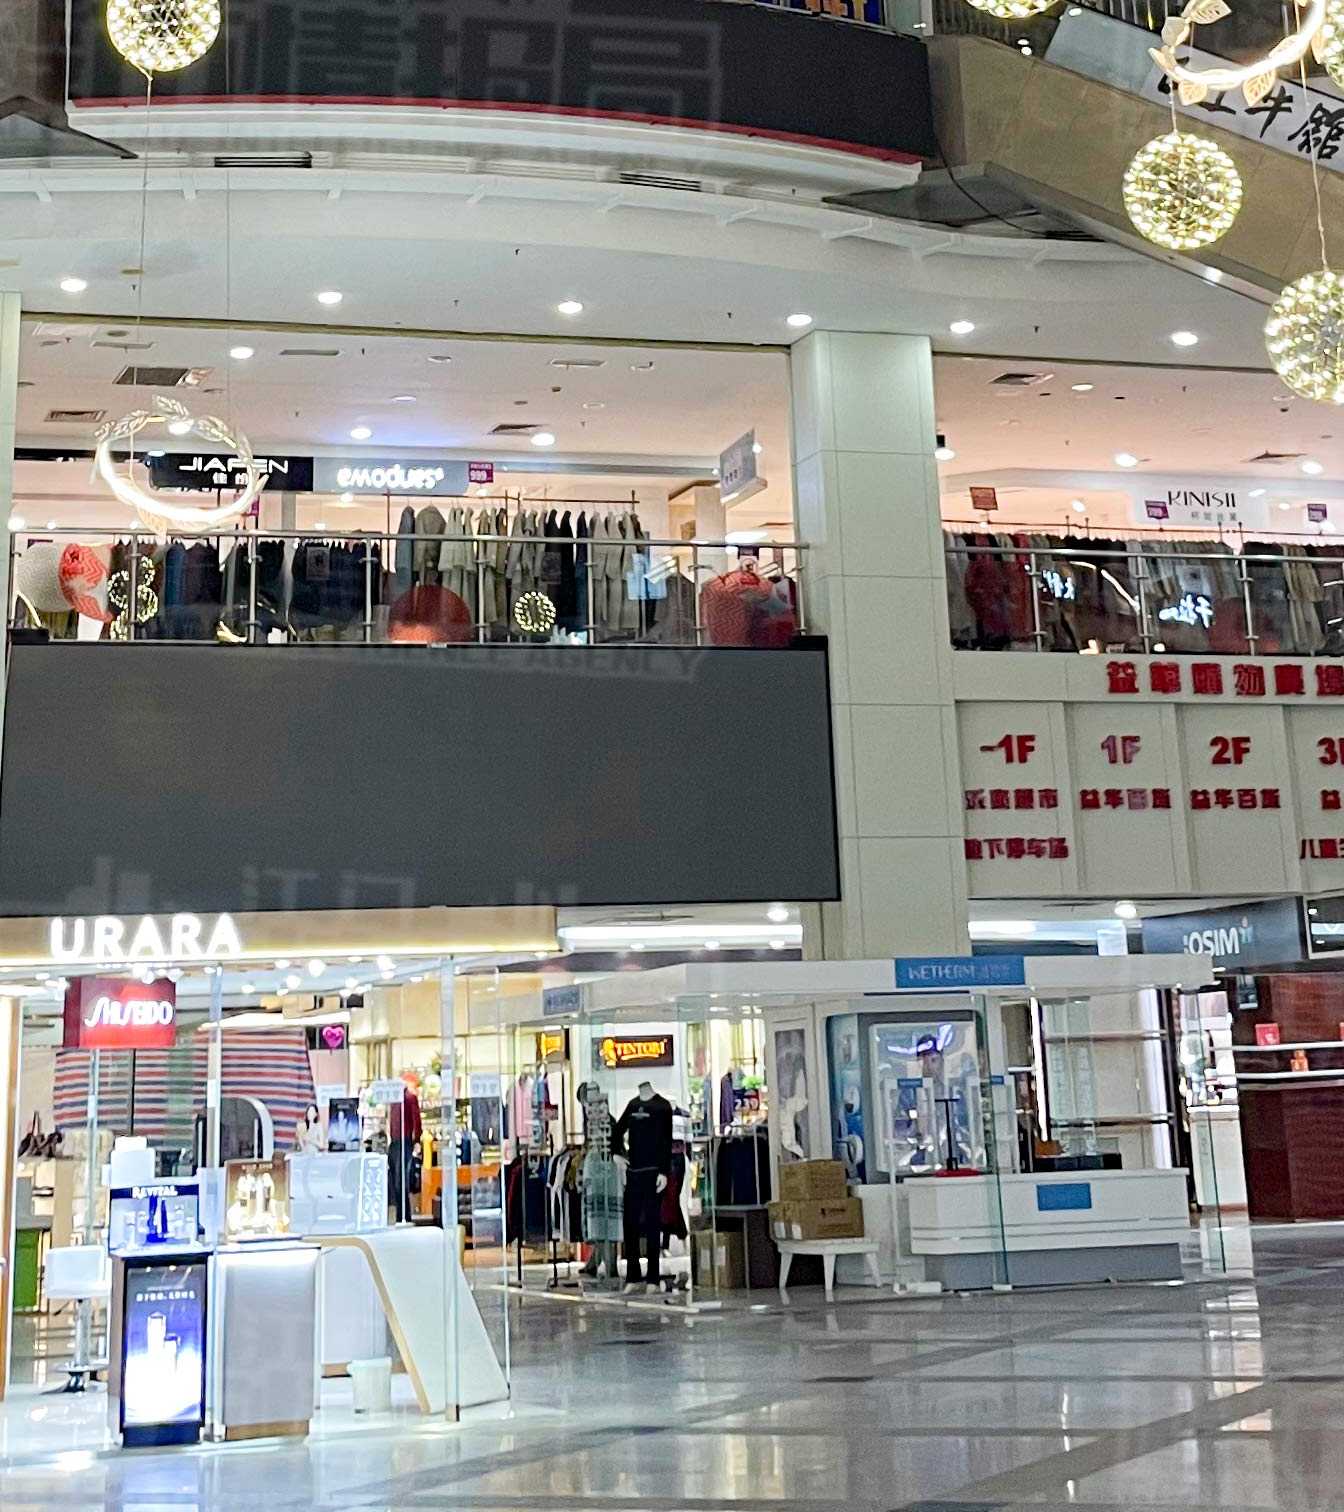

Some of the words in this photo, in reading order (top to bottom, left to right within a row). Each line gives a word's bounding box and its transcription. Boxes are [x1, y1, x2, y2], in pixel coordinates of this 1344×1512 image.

[1101, 735, 1141, 765] 1F
[1210, 736, 1251, 766] 2F
[51, 913, 243, 959] URARA
[1189, 926, 1240, 957] OSIM
